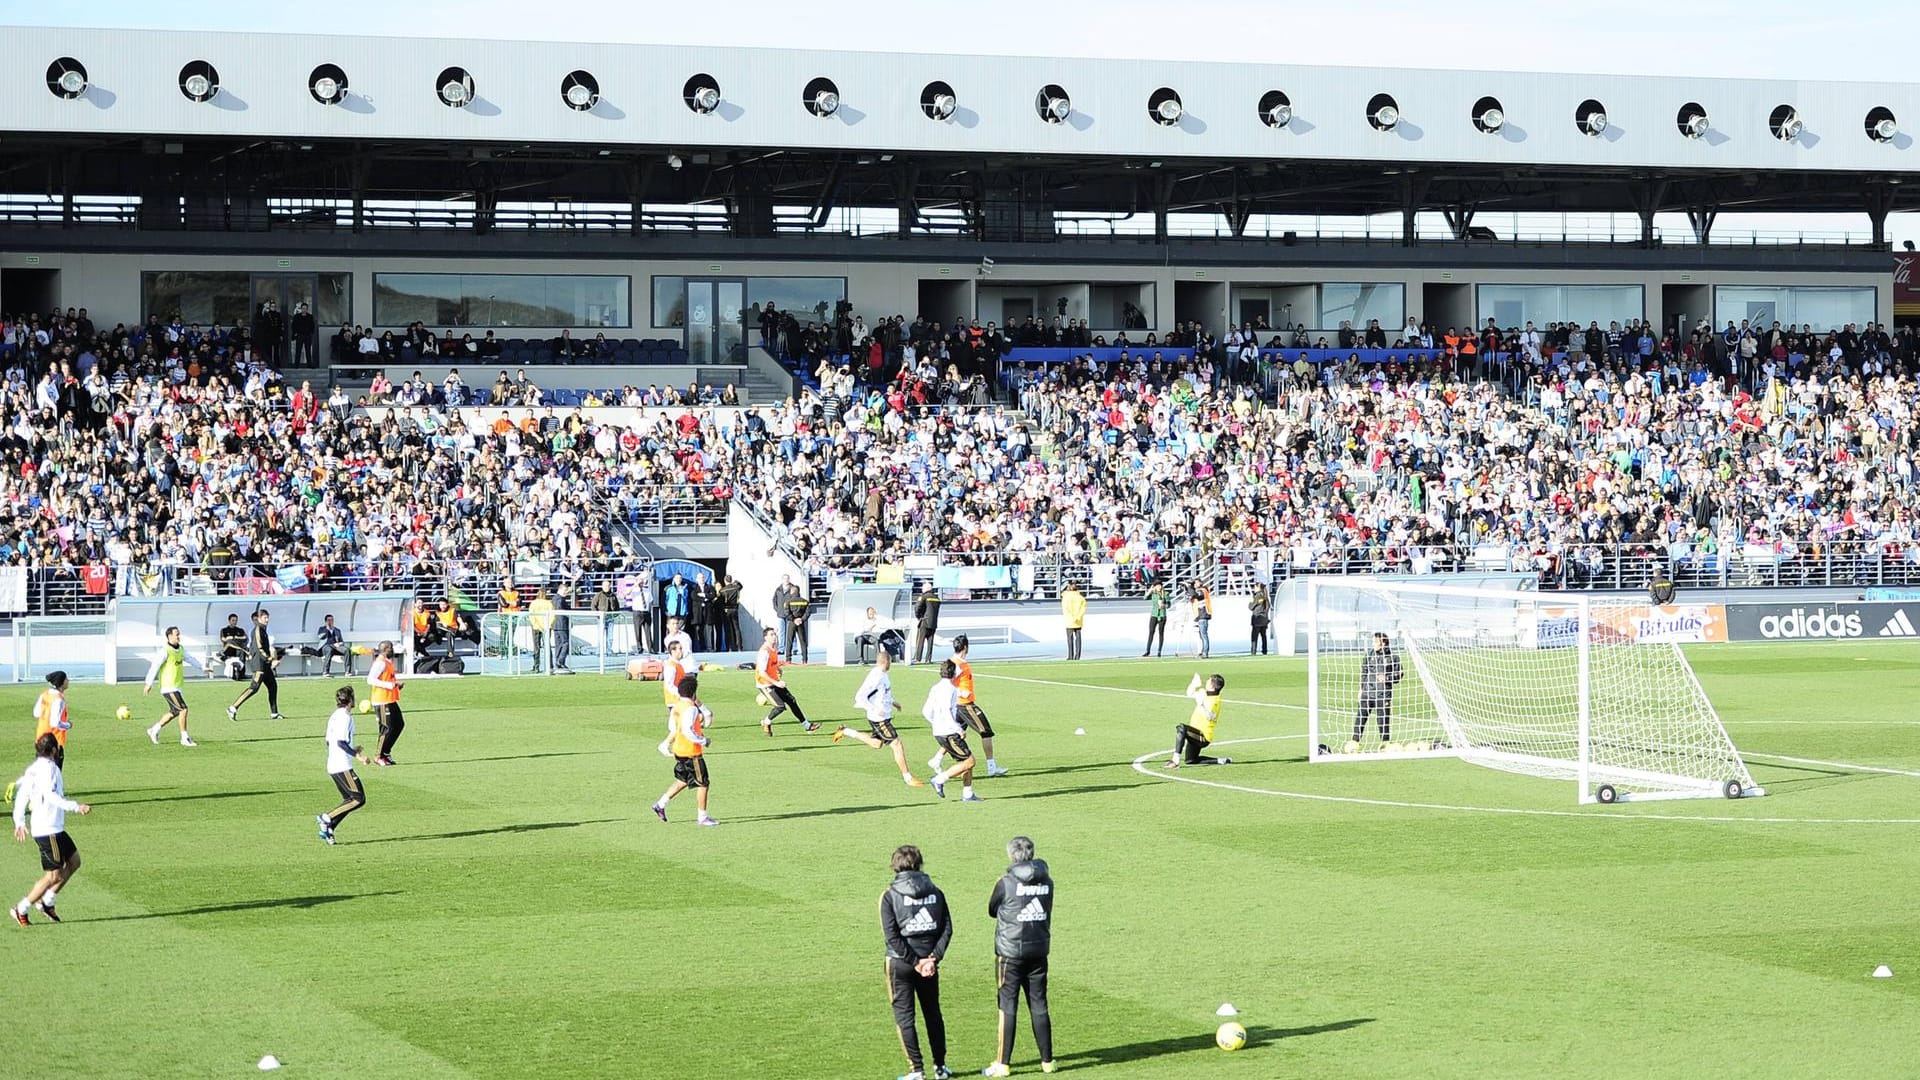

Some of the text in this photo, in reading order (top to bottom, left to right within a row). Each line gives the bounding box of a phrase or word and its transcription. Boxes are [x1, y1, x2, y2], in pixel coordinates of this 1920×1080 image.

[90, 565, 105, 578] 20
[1759, 608, 1863, 638] adidas
[1016, 883, 1049, 897] bwin
[1016, 911, 1047, 922] adidas
[906, 921, 937, 933] adidas
